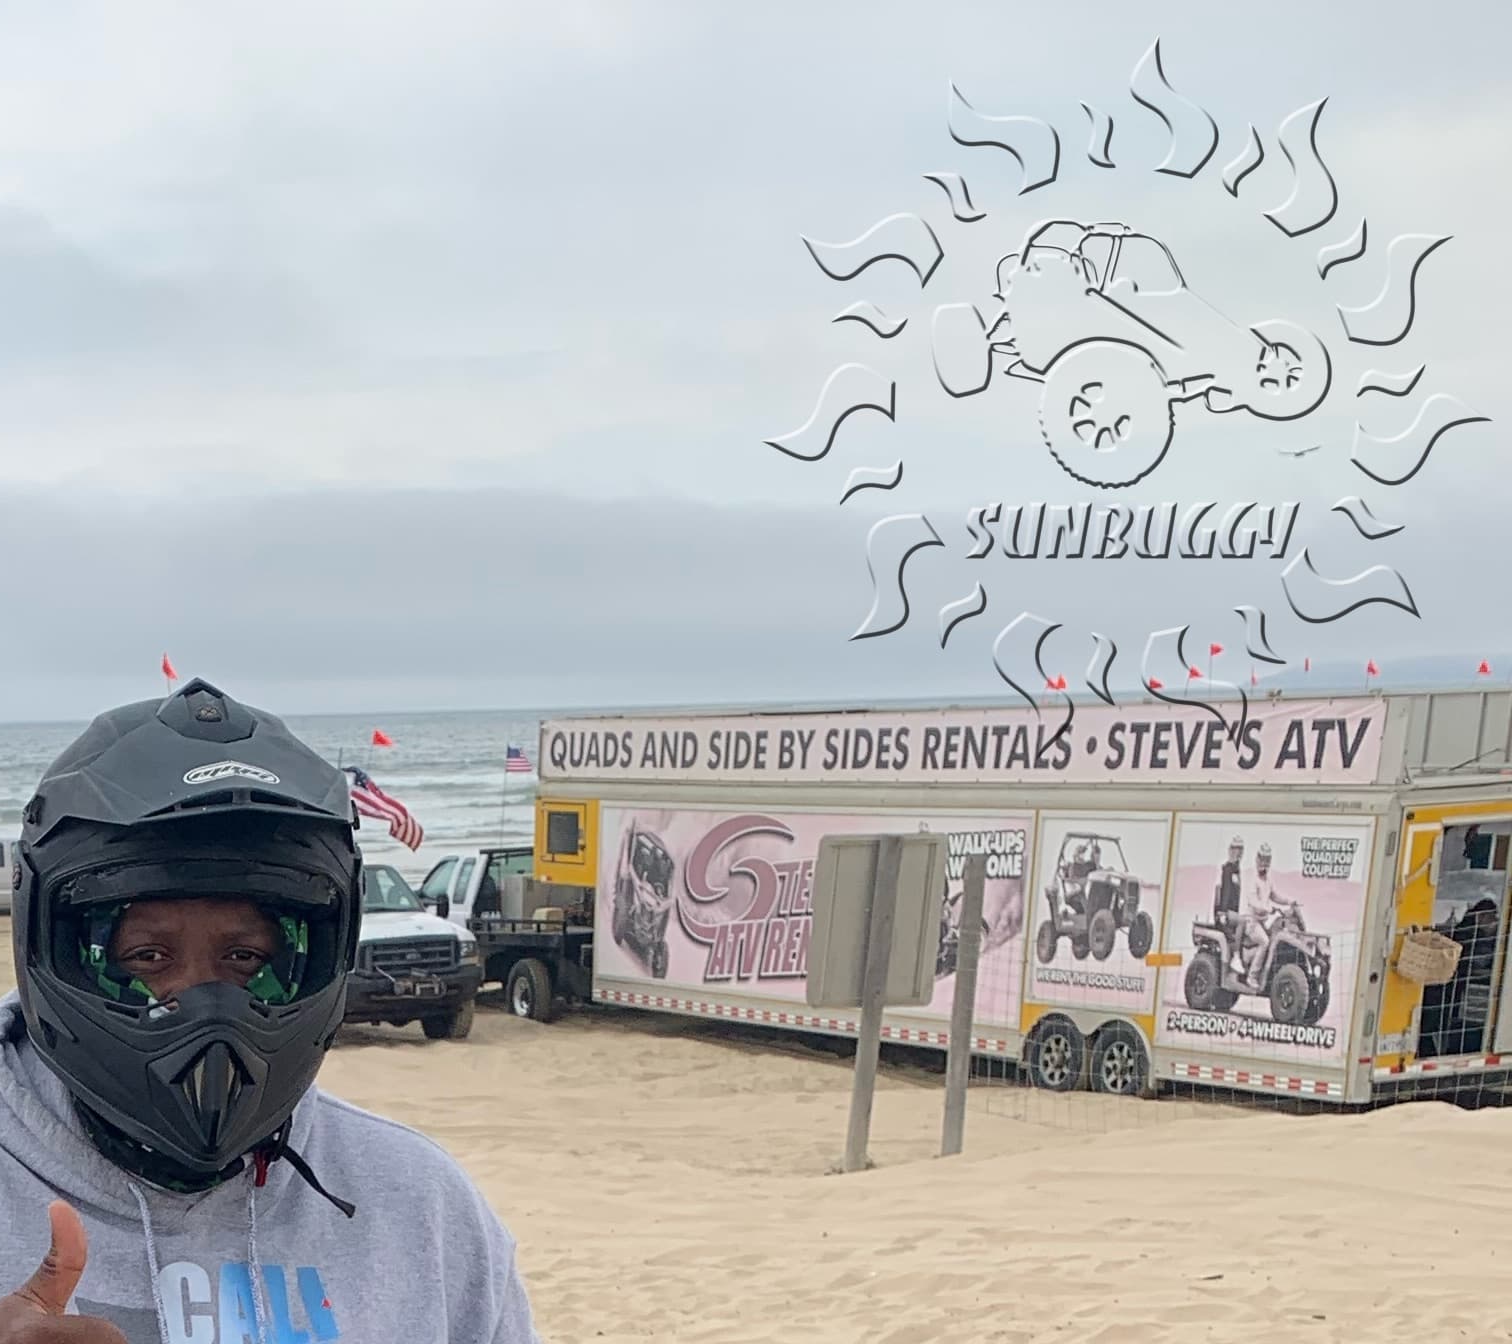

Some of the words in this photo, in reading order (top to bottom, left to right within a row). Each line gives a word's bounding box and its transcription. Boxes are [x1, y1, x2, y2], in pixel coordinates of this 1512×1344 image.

[549, 730, 633, 772] QUADS
[640, 730, 699, 769] AND
[706, 729, 769, 770] SIDE
[777, 728, 817, 770] BY
[821, 725, 911, 771] SIDES
[920, 724, 1073, 771] RENTALS
[1103, 719, 1264, 771] STEVE'S
[1274, 716, 1372, 770] ATV
[947, 829, 1026, 857] WALK-UPS
[947, 853, 1024, 879] WOME
[704, 918, 768, 982] ATV
[1167, 1011, 1228, 1037] 2-PERSON
[1295, 1024, 1336, 1048] DRIVE
